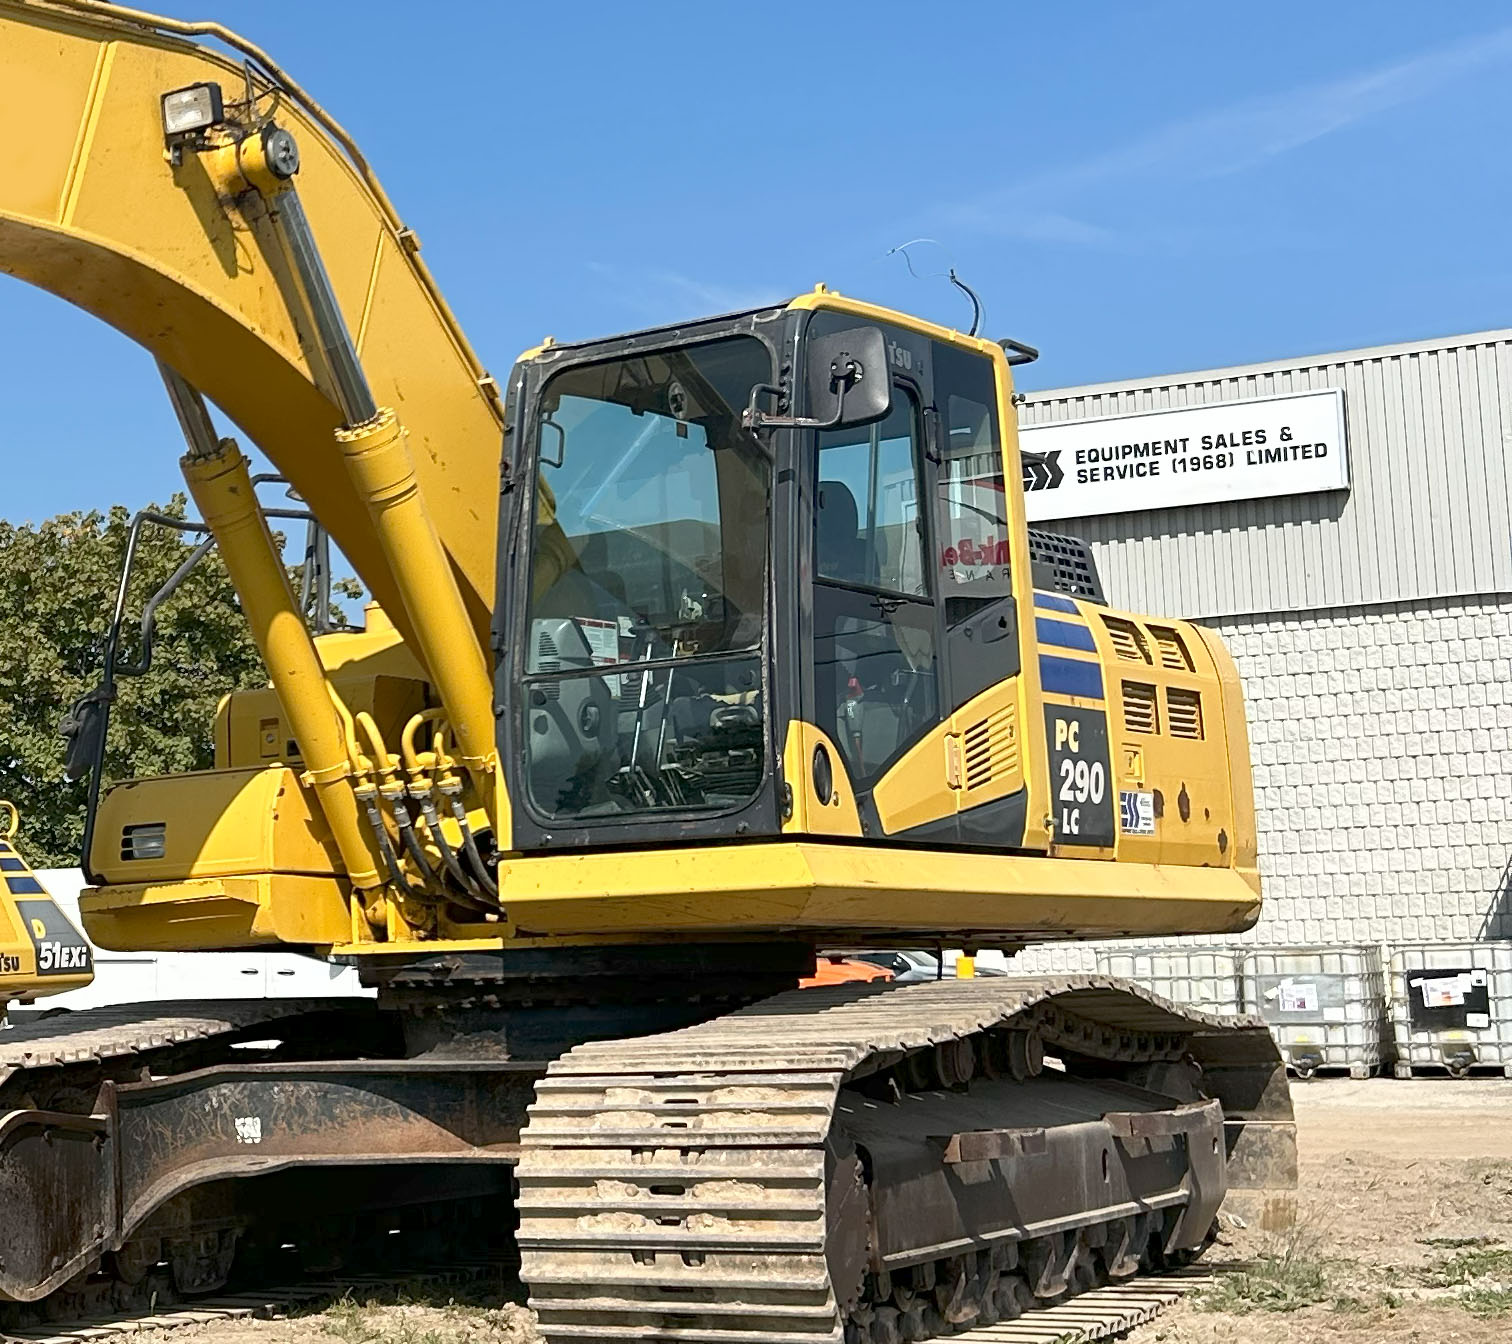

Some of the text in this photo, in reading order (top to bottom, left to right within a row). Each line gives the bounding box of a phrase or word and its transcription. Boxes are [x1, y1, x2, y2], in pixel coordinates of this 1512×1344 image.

[1075, 425, 1294, 465] EQUIPMENT SALES &
[1076, 442, 1328, 485] SERVICE (1968) LIMITED
[1054, 718, 1080, 753] PC
[1059, 758, 1105, 805] 290
[1061, 807, 1080, 835] LC
[30, 918, 47, 939] D
